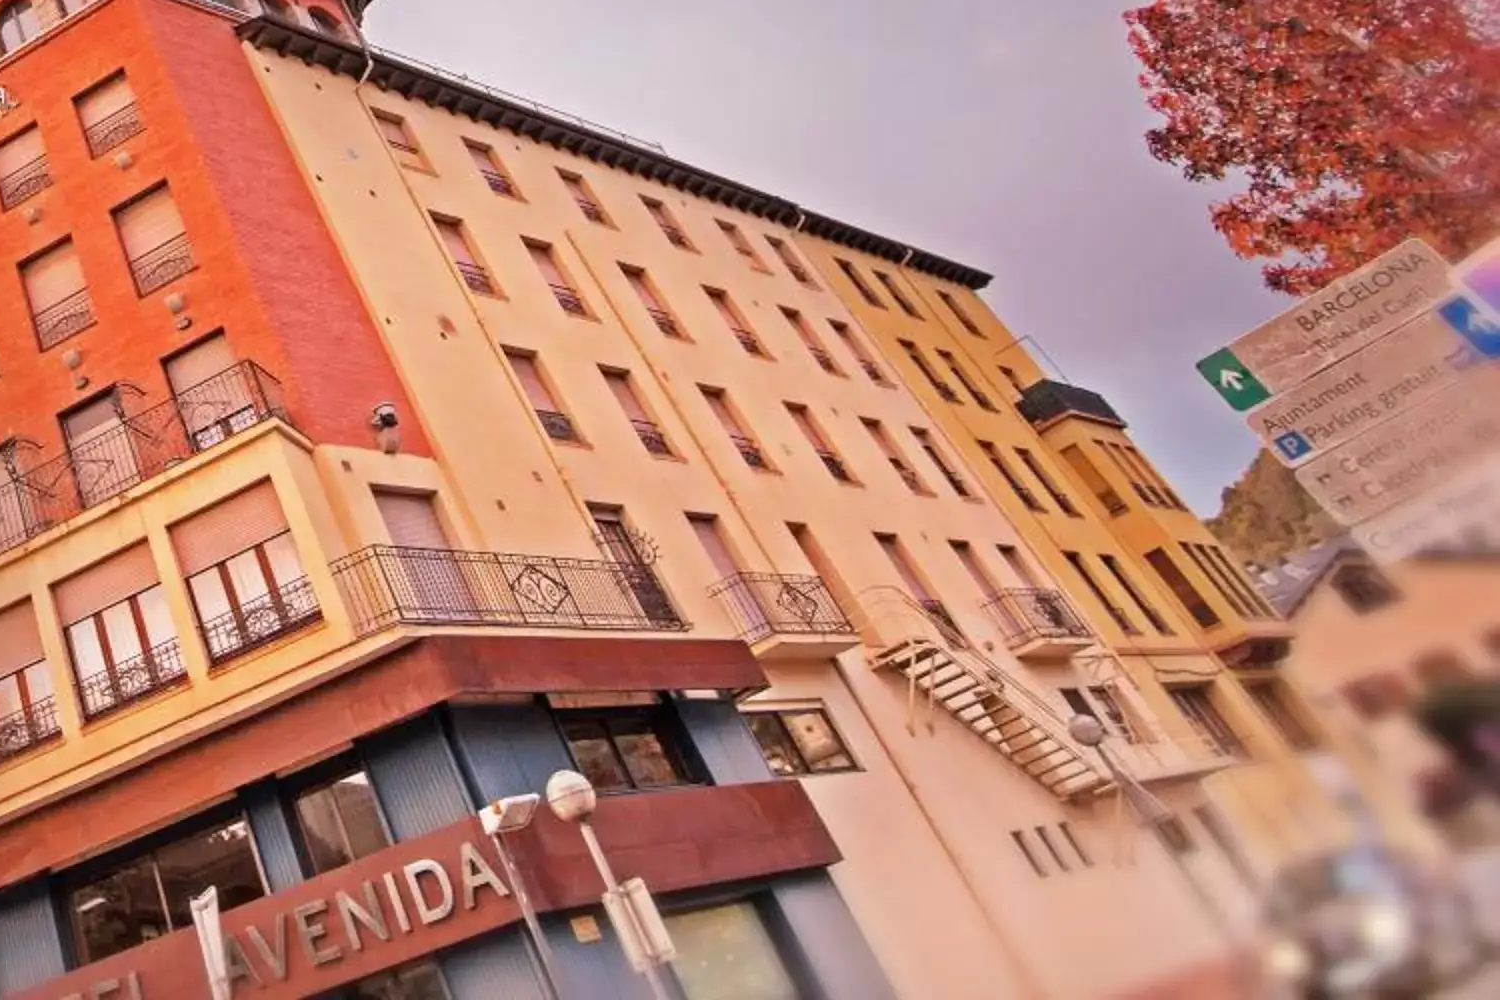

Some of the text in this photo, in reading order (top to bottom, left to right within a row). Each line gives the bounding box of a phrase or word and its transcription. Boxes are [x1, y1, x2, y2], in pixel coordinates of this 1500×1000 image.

[1295, 252, 1430, 333] BARCELONA
[1262, 371, 1370, 434] Ajuntament
[1301, 400, 1381, 443] Parking
[221, 841, 510, 986] AVENIDA
